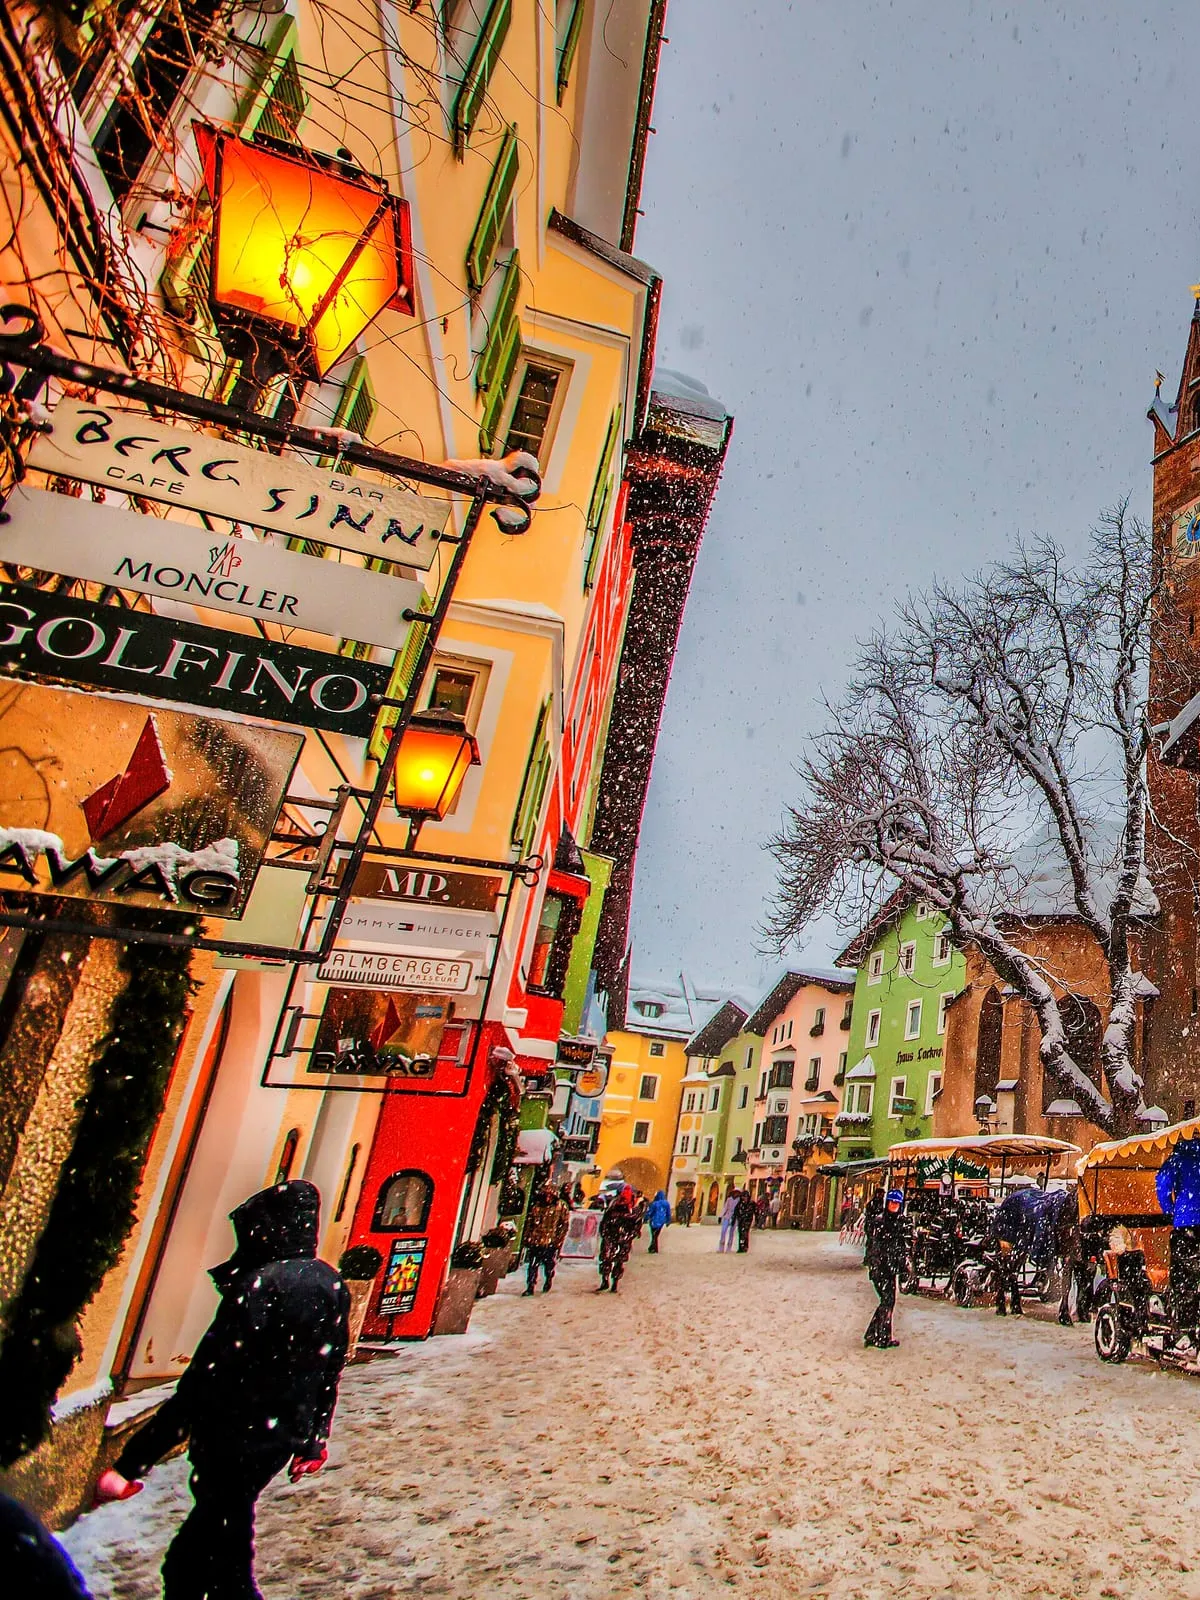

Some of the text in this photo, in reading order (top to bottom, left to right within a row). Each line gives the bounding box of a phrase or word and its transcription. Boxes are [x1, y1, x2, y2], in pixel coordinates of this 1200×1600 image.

[75, 409, 241, 487] BERG
[106, 464, 186, 495] CAFÉ
[328, 477, 385, 502] BAR
[261, 486, 424, 548] SINN
[113, 556, 299, 617] MONCLER
[377, 869, 451, 901] MP.
[342, 916, 482, 939] OMMY HILFIGER
[332, 953, 461, 977] ALMBERGER
